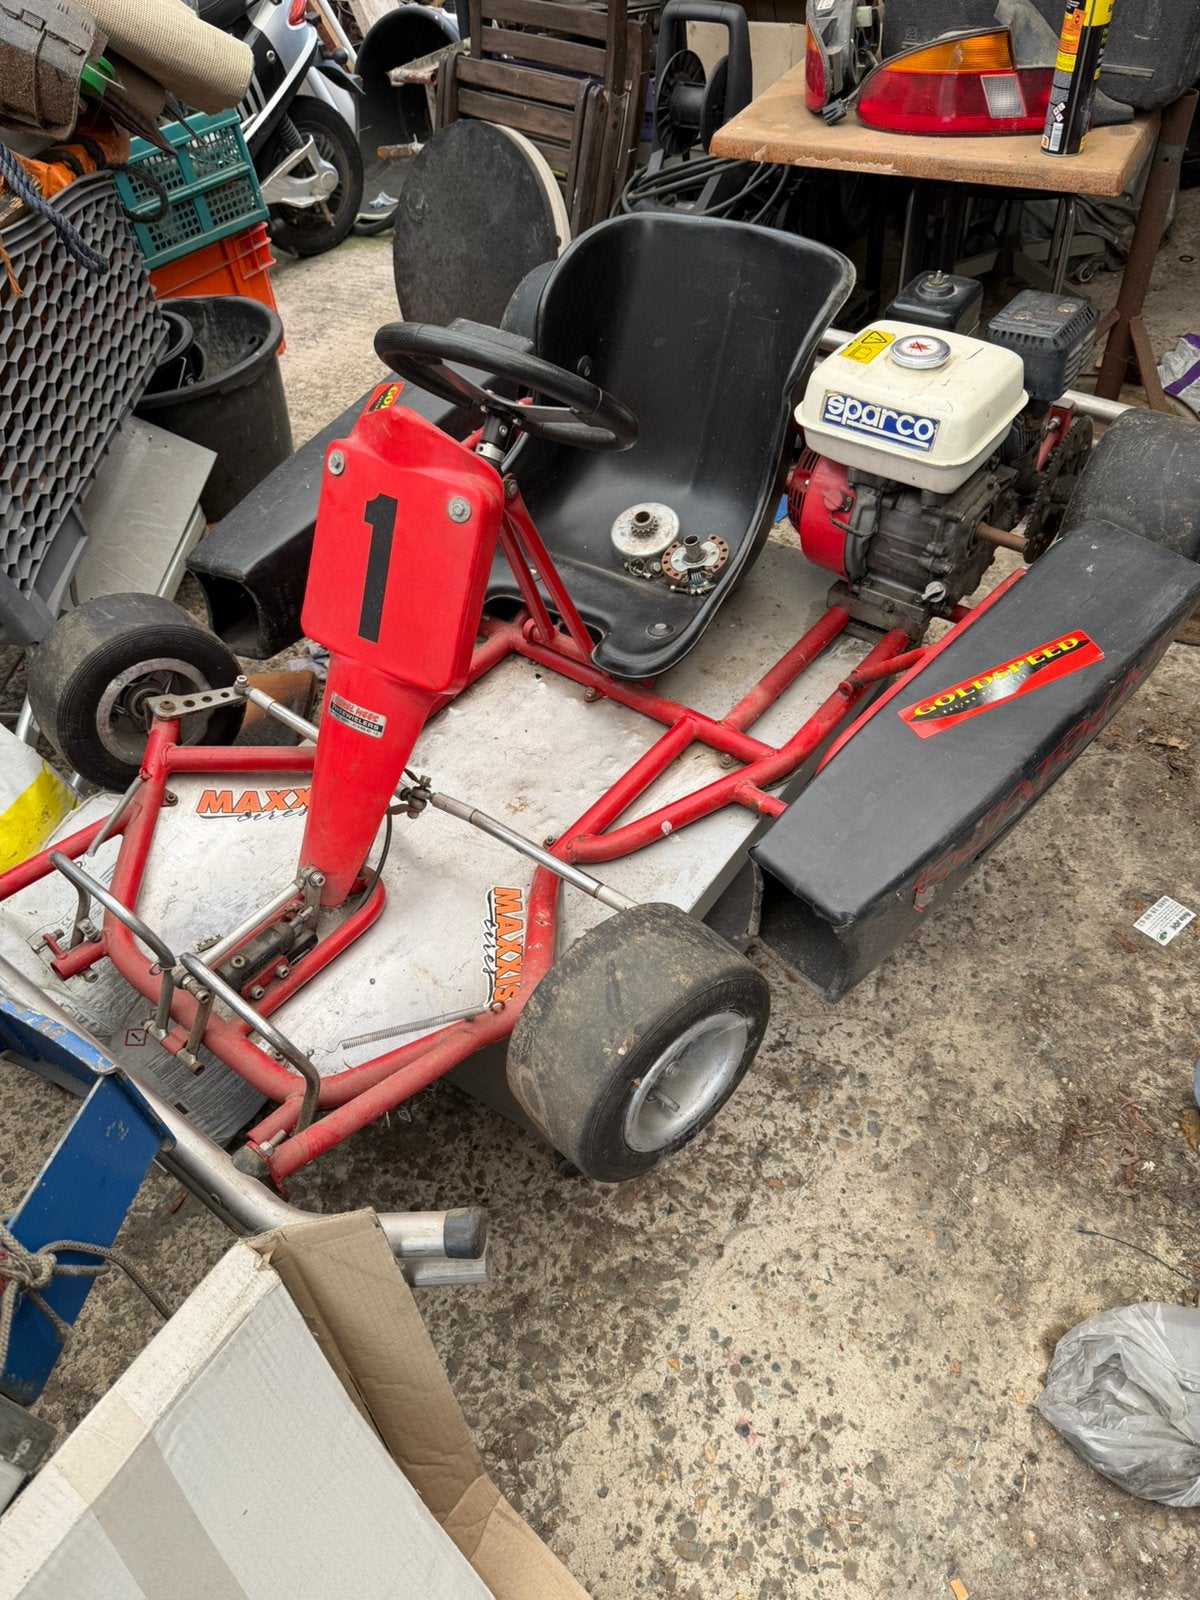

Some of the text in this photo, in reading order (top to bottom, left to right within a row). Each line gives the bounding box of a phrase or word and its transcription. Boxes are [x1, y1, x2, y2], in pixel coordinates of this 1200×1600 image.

[827, 394, 936, 442] sparco
[357, 493, 398, 643] 1
[914, 637, 1079, 717] GOLDSPEED
[494, 886, 524, 1002] MAXXIS
